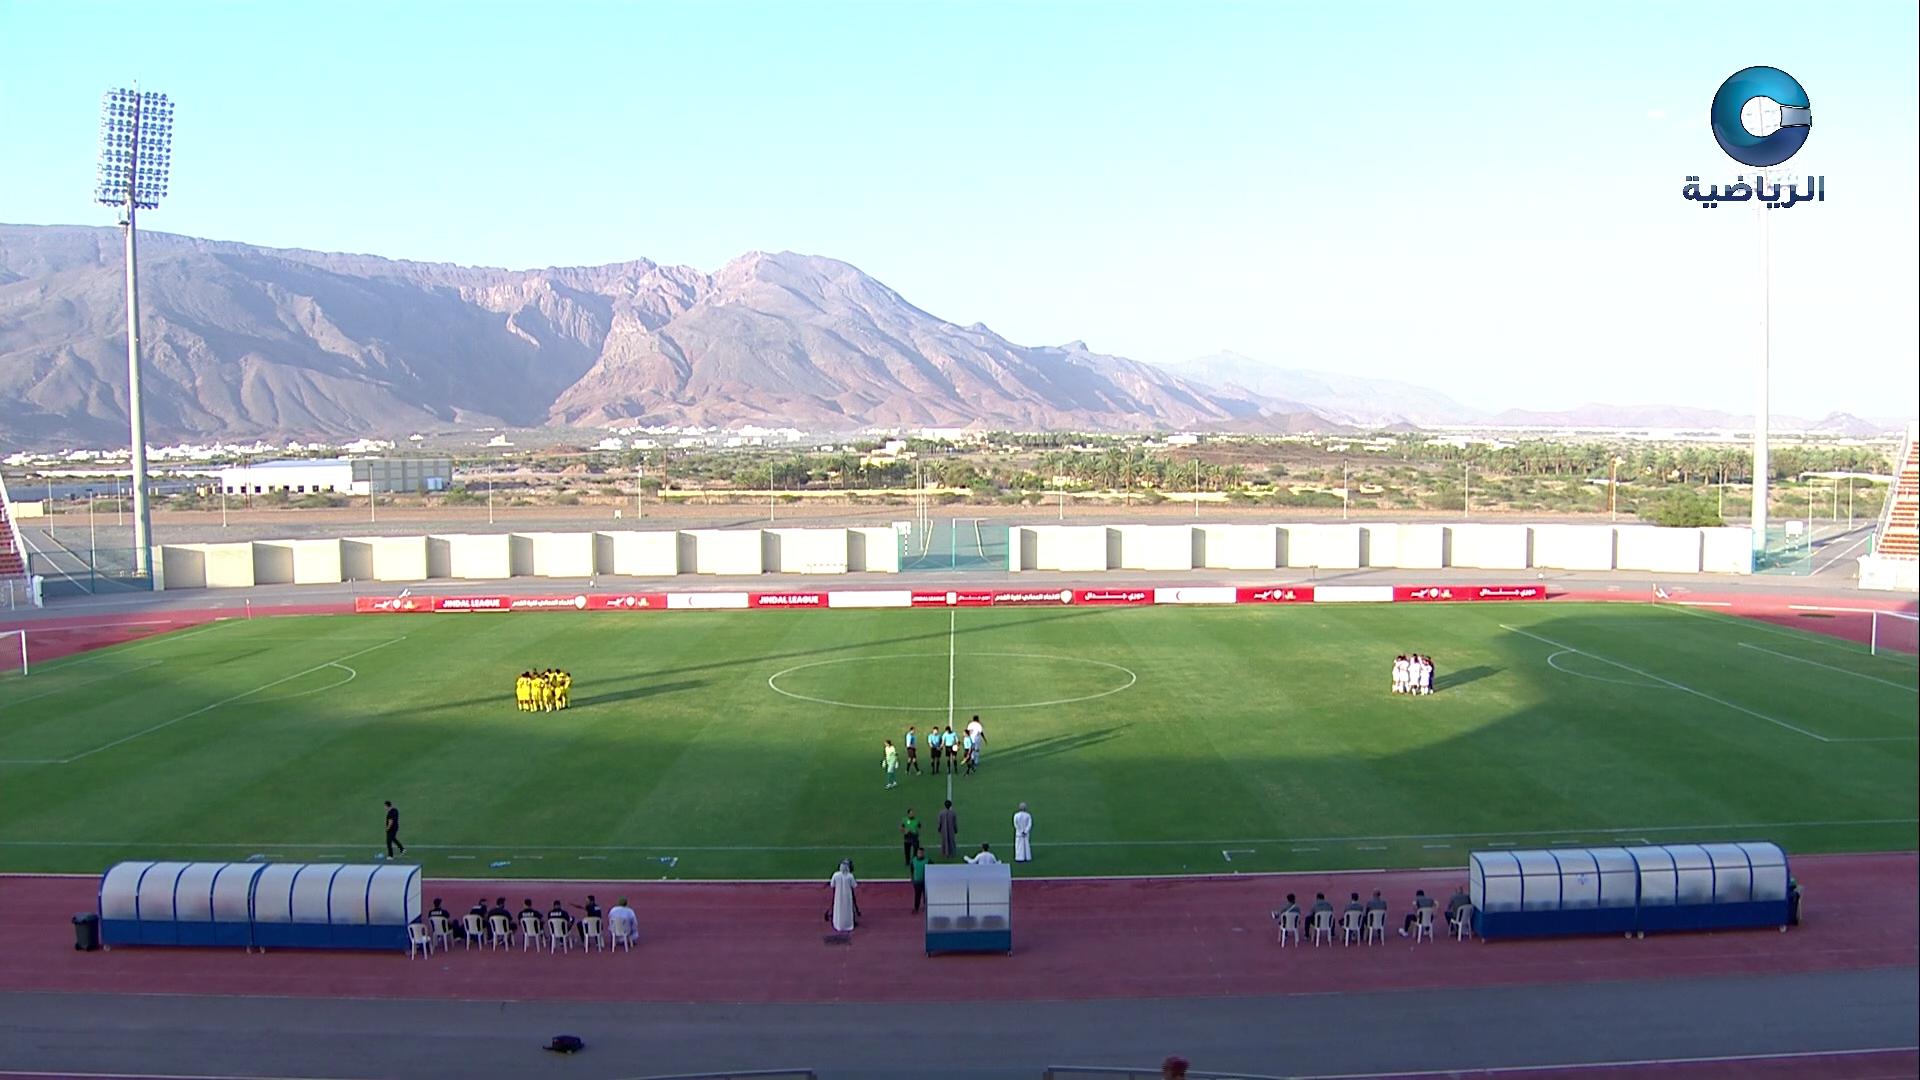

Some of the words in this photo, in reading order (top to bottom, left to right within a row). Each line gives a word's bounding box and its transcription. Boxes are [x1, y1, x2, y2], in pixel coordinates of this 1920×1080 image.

[443, 600, 470, 608] JINDAL
[471, 599, 500, 607] LEAGUE
[759, 596, 788, 604] JINDAL
[788, 595, 819, 604] LEAGUE
